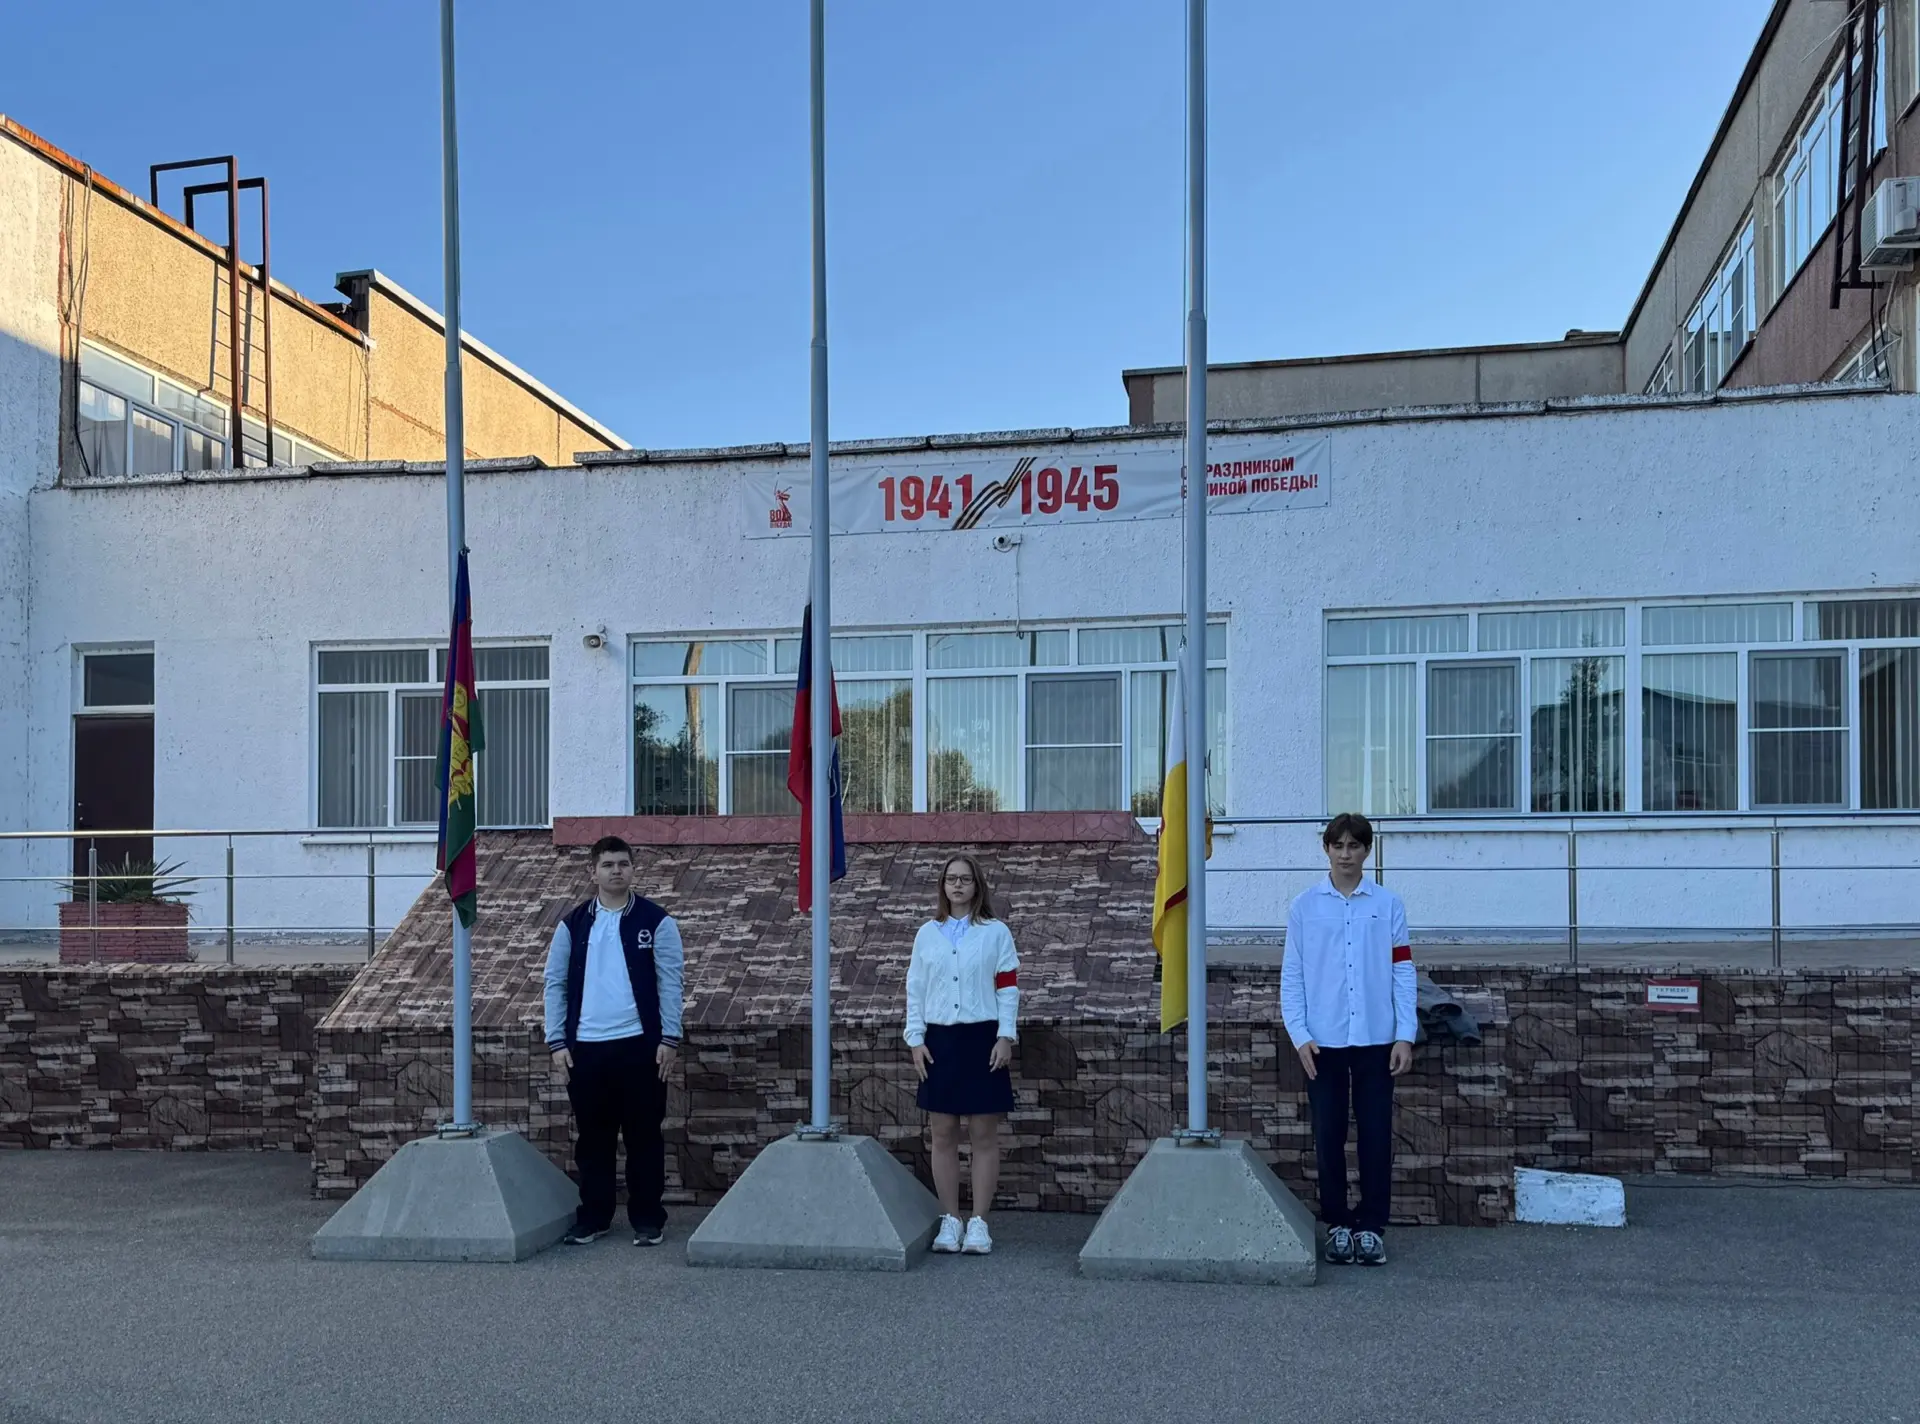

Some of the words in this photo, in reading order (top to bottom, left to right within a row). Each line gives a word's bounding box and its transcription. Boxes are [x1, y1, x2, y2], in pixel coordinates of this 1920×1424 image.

[1206, 456, 1294, 478] РАЗДНИКОМ
[877, 473, 973, 522] 1941
[1020, 464, 1120, 515] 1945
[1251, 474, 1318, 493] ПОБЕДЫ!
